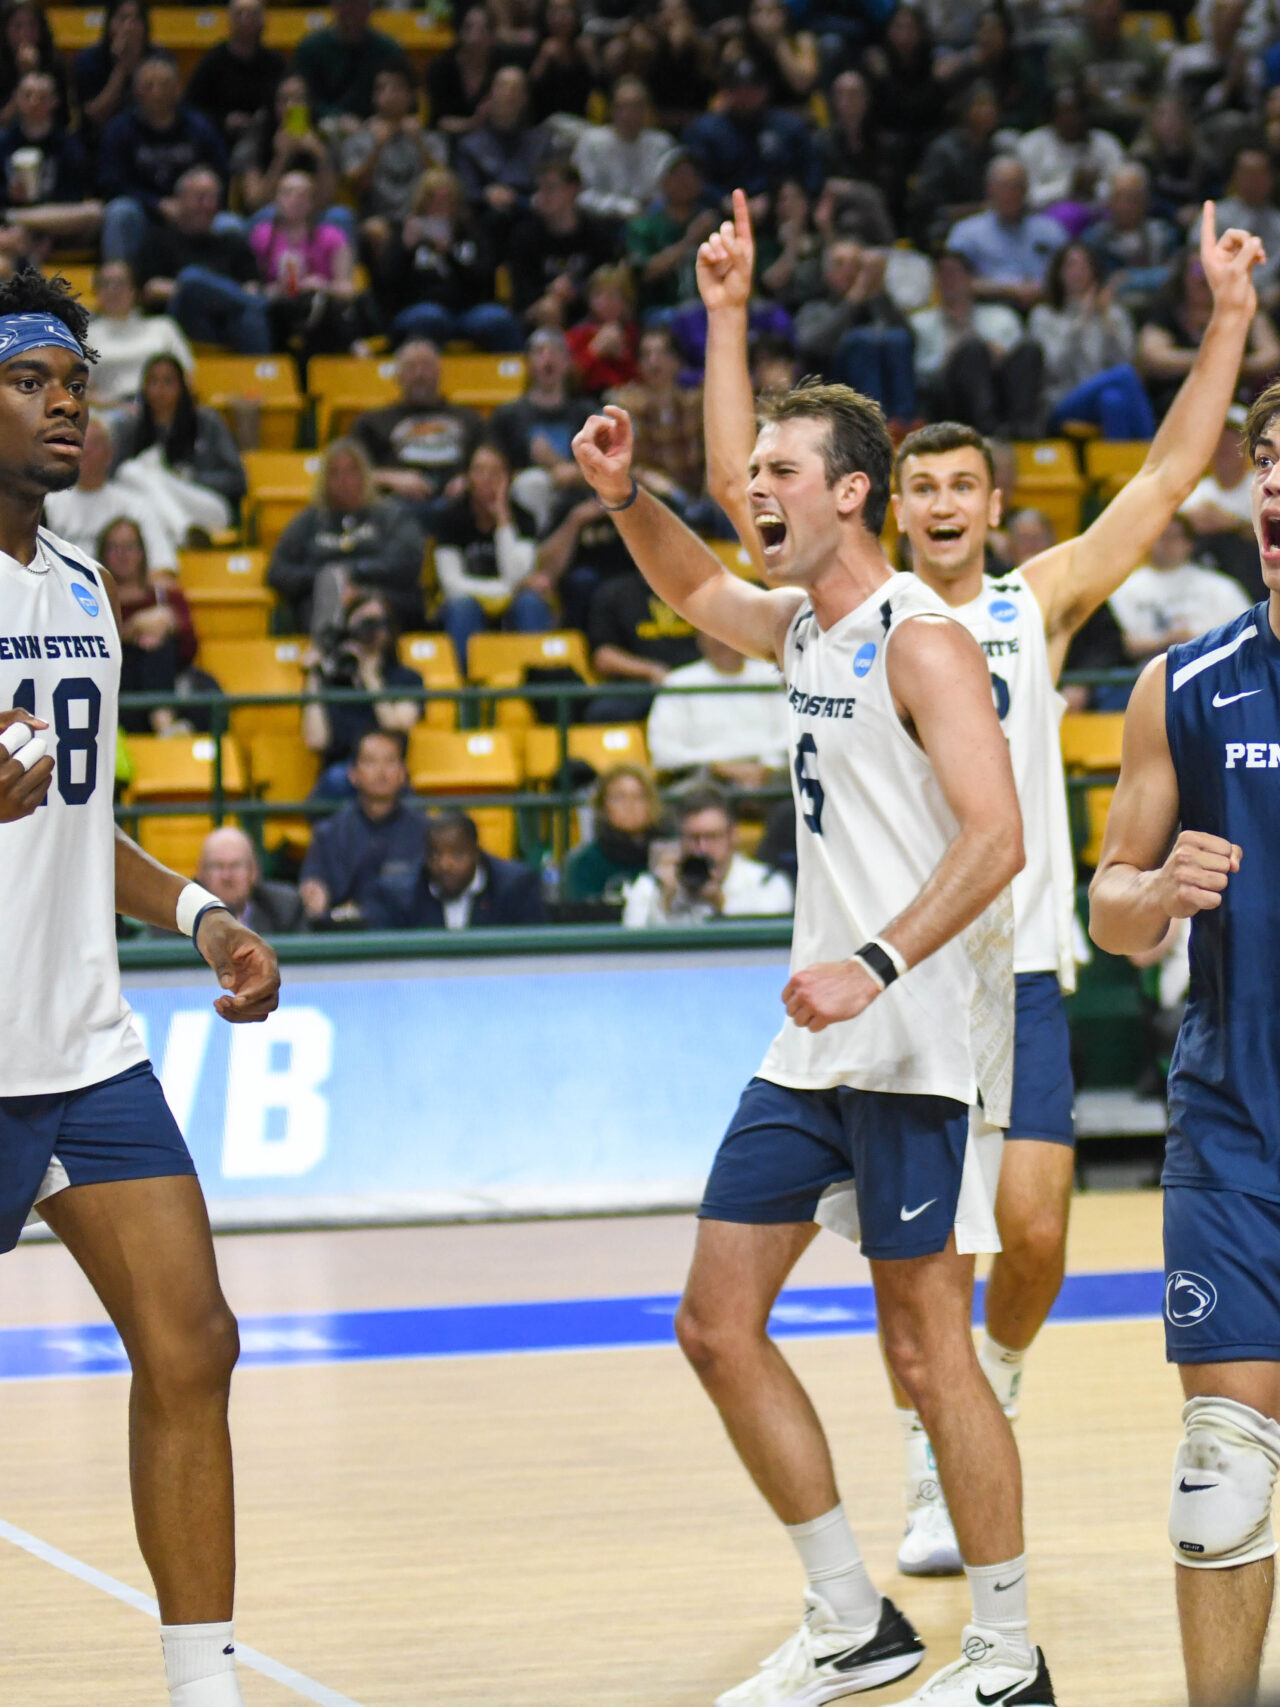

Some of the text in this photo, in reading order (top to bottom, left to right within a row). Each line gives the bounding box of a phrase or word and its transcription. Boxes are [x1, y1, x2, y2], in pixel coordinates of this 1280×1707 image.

[0, 635, 110, 660] ENN STATE
[980, 636, 1019, 657] ATE
